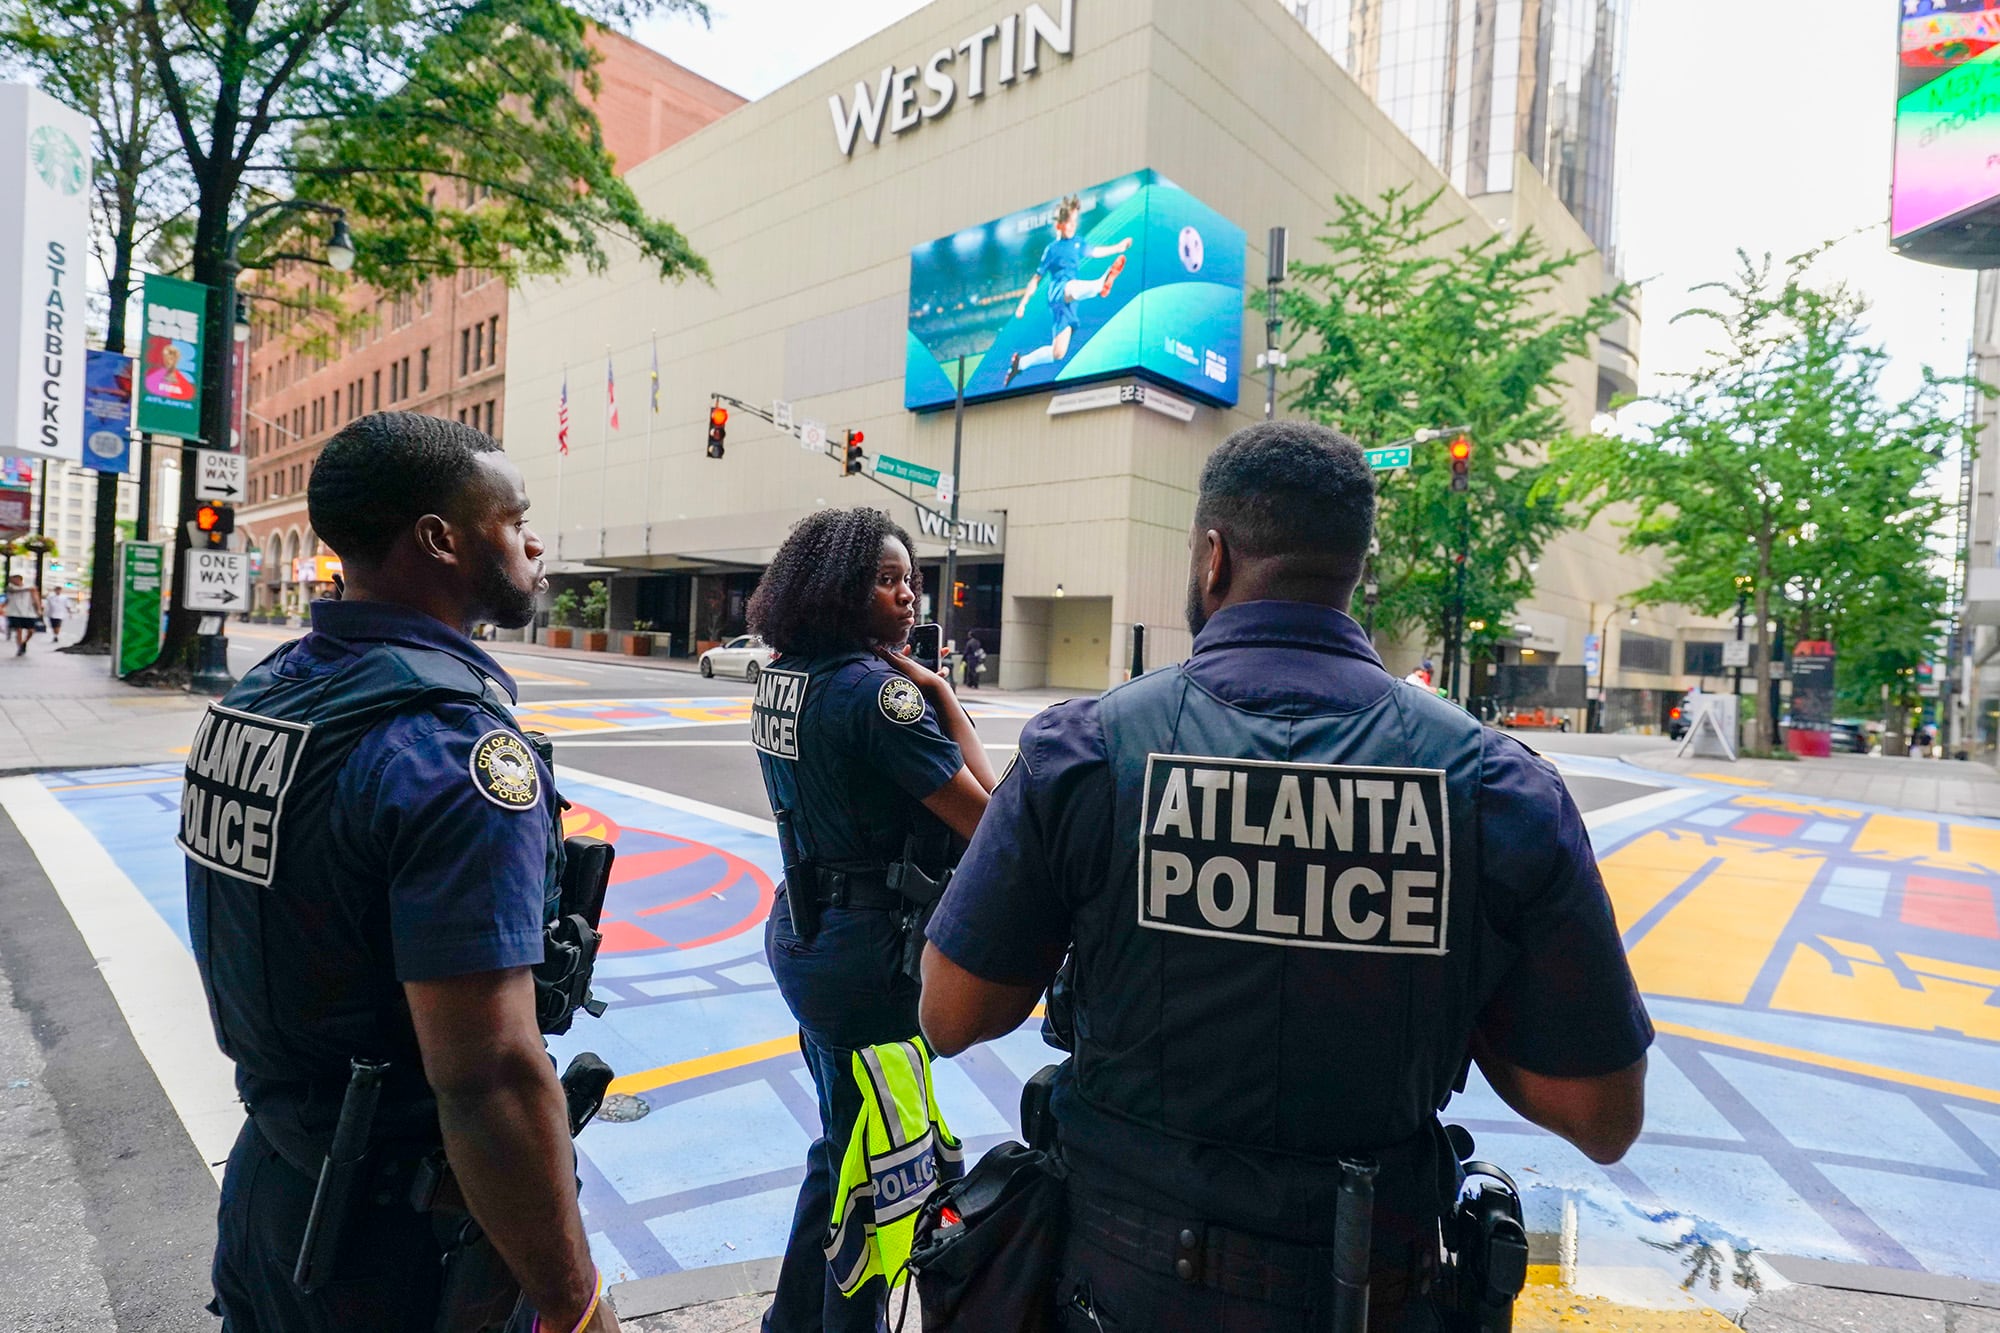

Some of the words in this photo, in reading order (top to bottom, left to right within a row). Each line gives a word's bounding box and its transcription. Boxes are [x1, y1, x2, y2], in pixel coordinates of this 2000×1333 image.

[828, 0, 1074, 155] WESTIN
[41, 241, 65, 448] STARBUCKS
[205, 467, 239, 481] WAY
[207, 455, 239, 469] ONE
[200, 554, 238, 570] ONE
[200, 570, 240, 585] WAY
[755, 673, 800, 713] LANTA
[897, 705, 922, 720] POLICE
[752, 710, 796, 755] OLICE
[478, 743, 493, 769] CITY
[492, 736, 507, 748] OF
[508, 738, 536, 780] ATLANTA
[488, 782, 534, 803] POLICE
[1152, 767, 1437, 856] ATLANTA
[1150, 849, 1438, 943] POLICE
